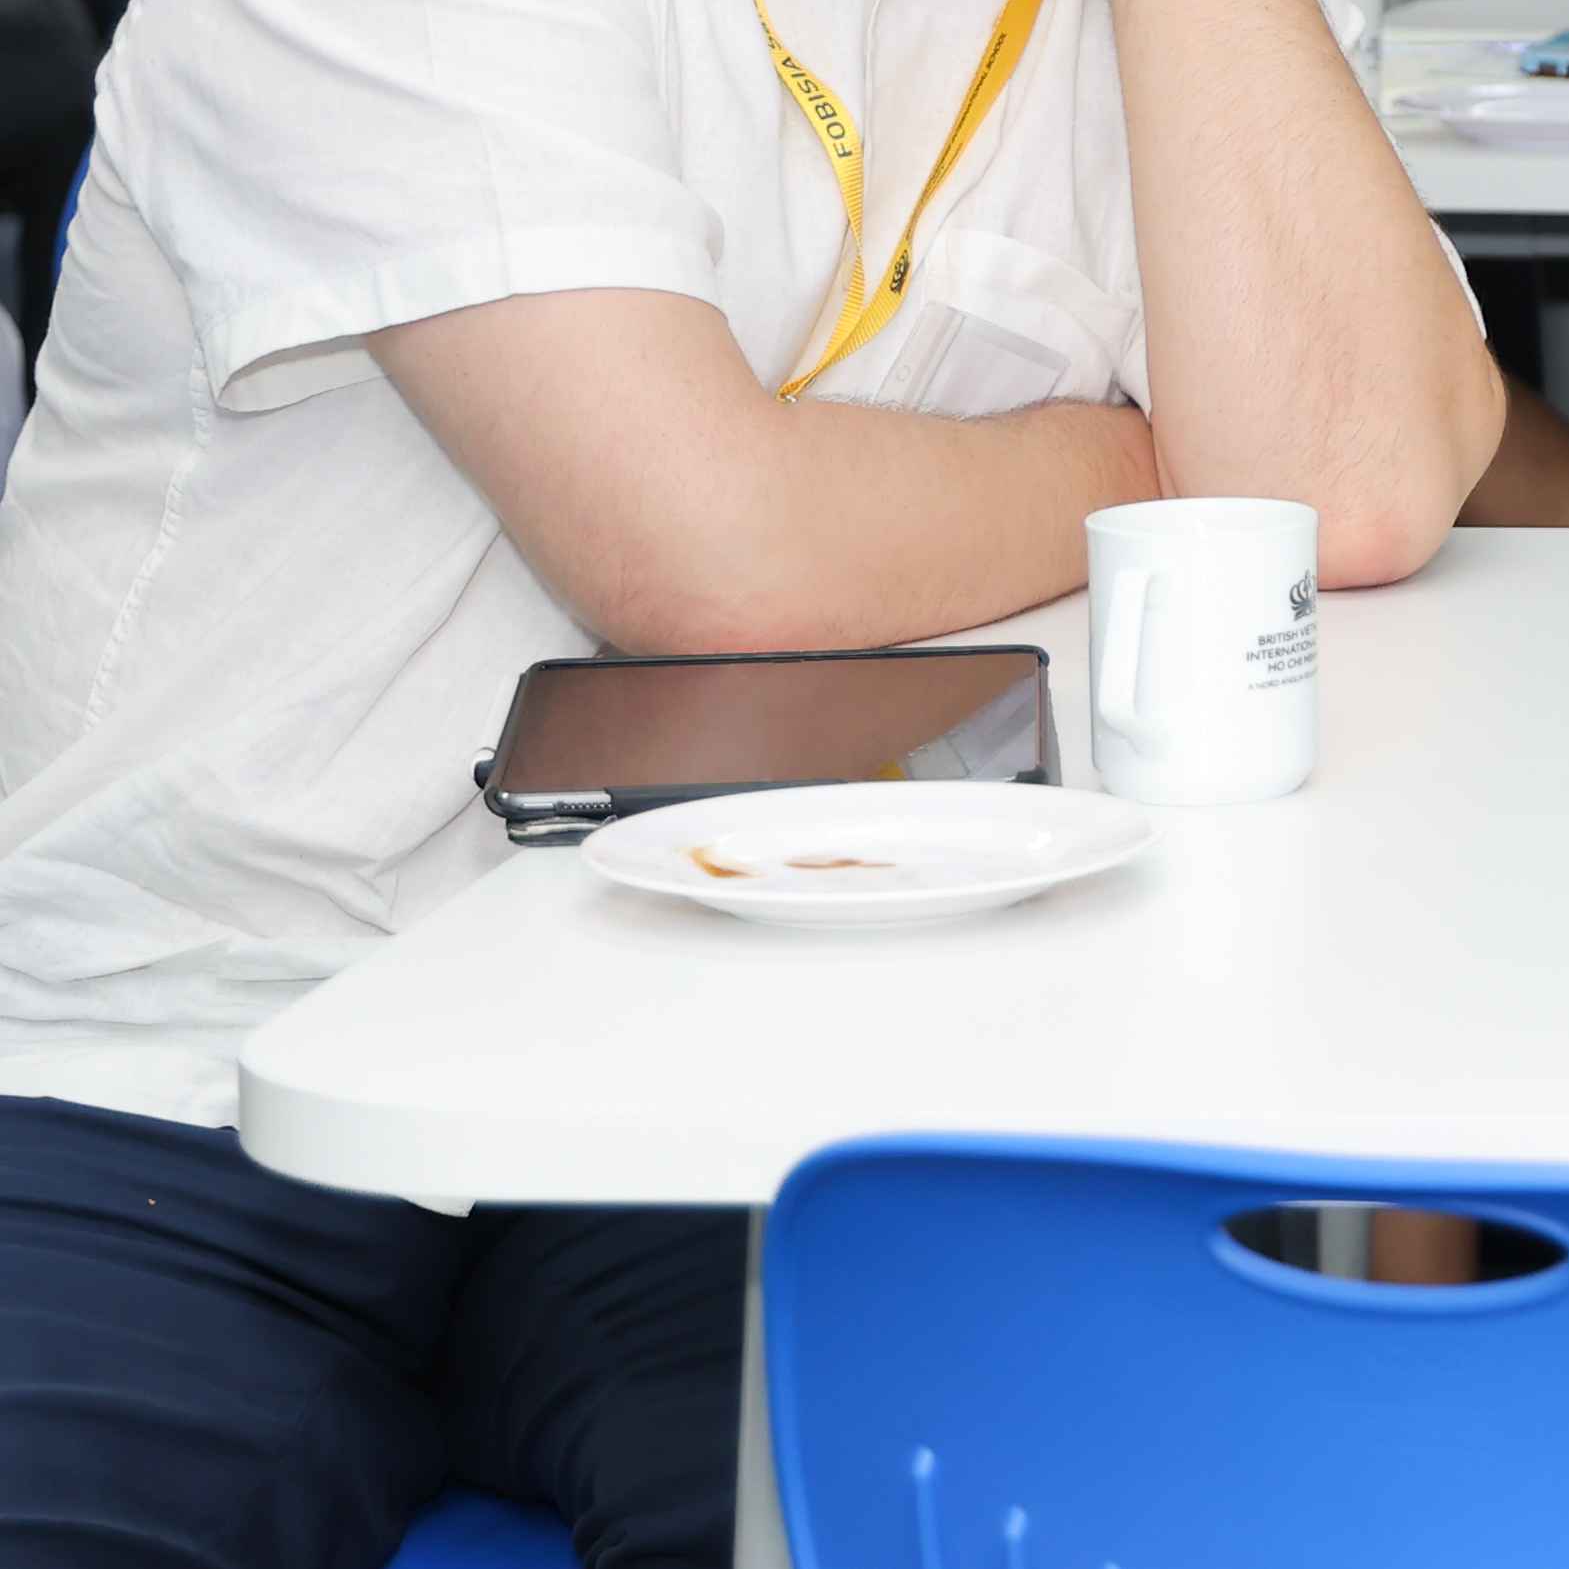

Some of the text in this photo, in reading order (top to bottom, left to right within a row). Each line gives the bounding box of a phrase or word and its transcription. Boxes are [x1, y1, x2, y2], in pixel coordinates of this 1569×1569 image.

[781, 56, 853, 159] FOBISIA
[1257, 630, 1299, 646] BRITISH
[1268, 660, 1286, 672] HO
